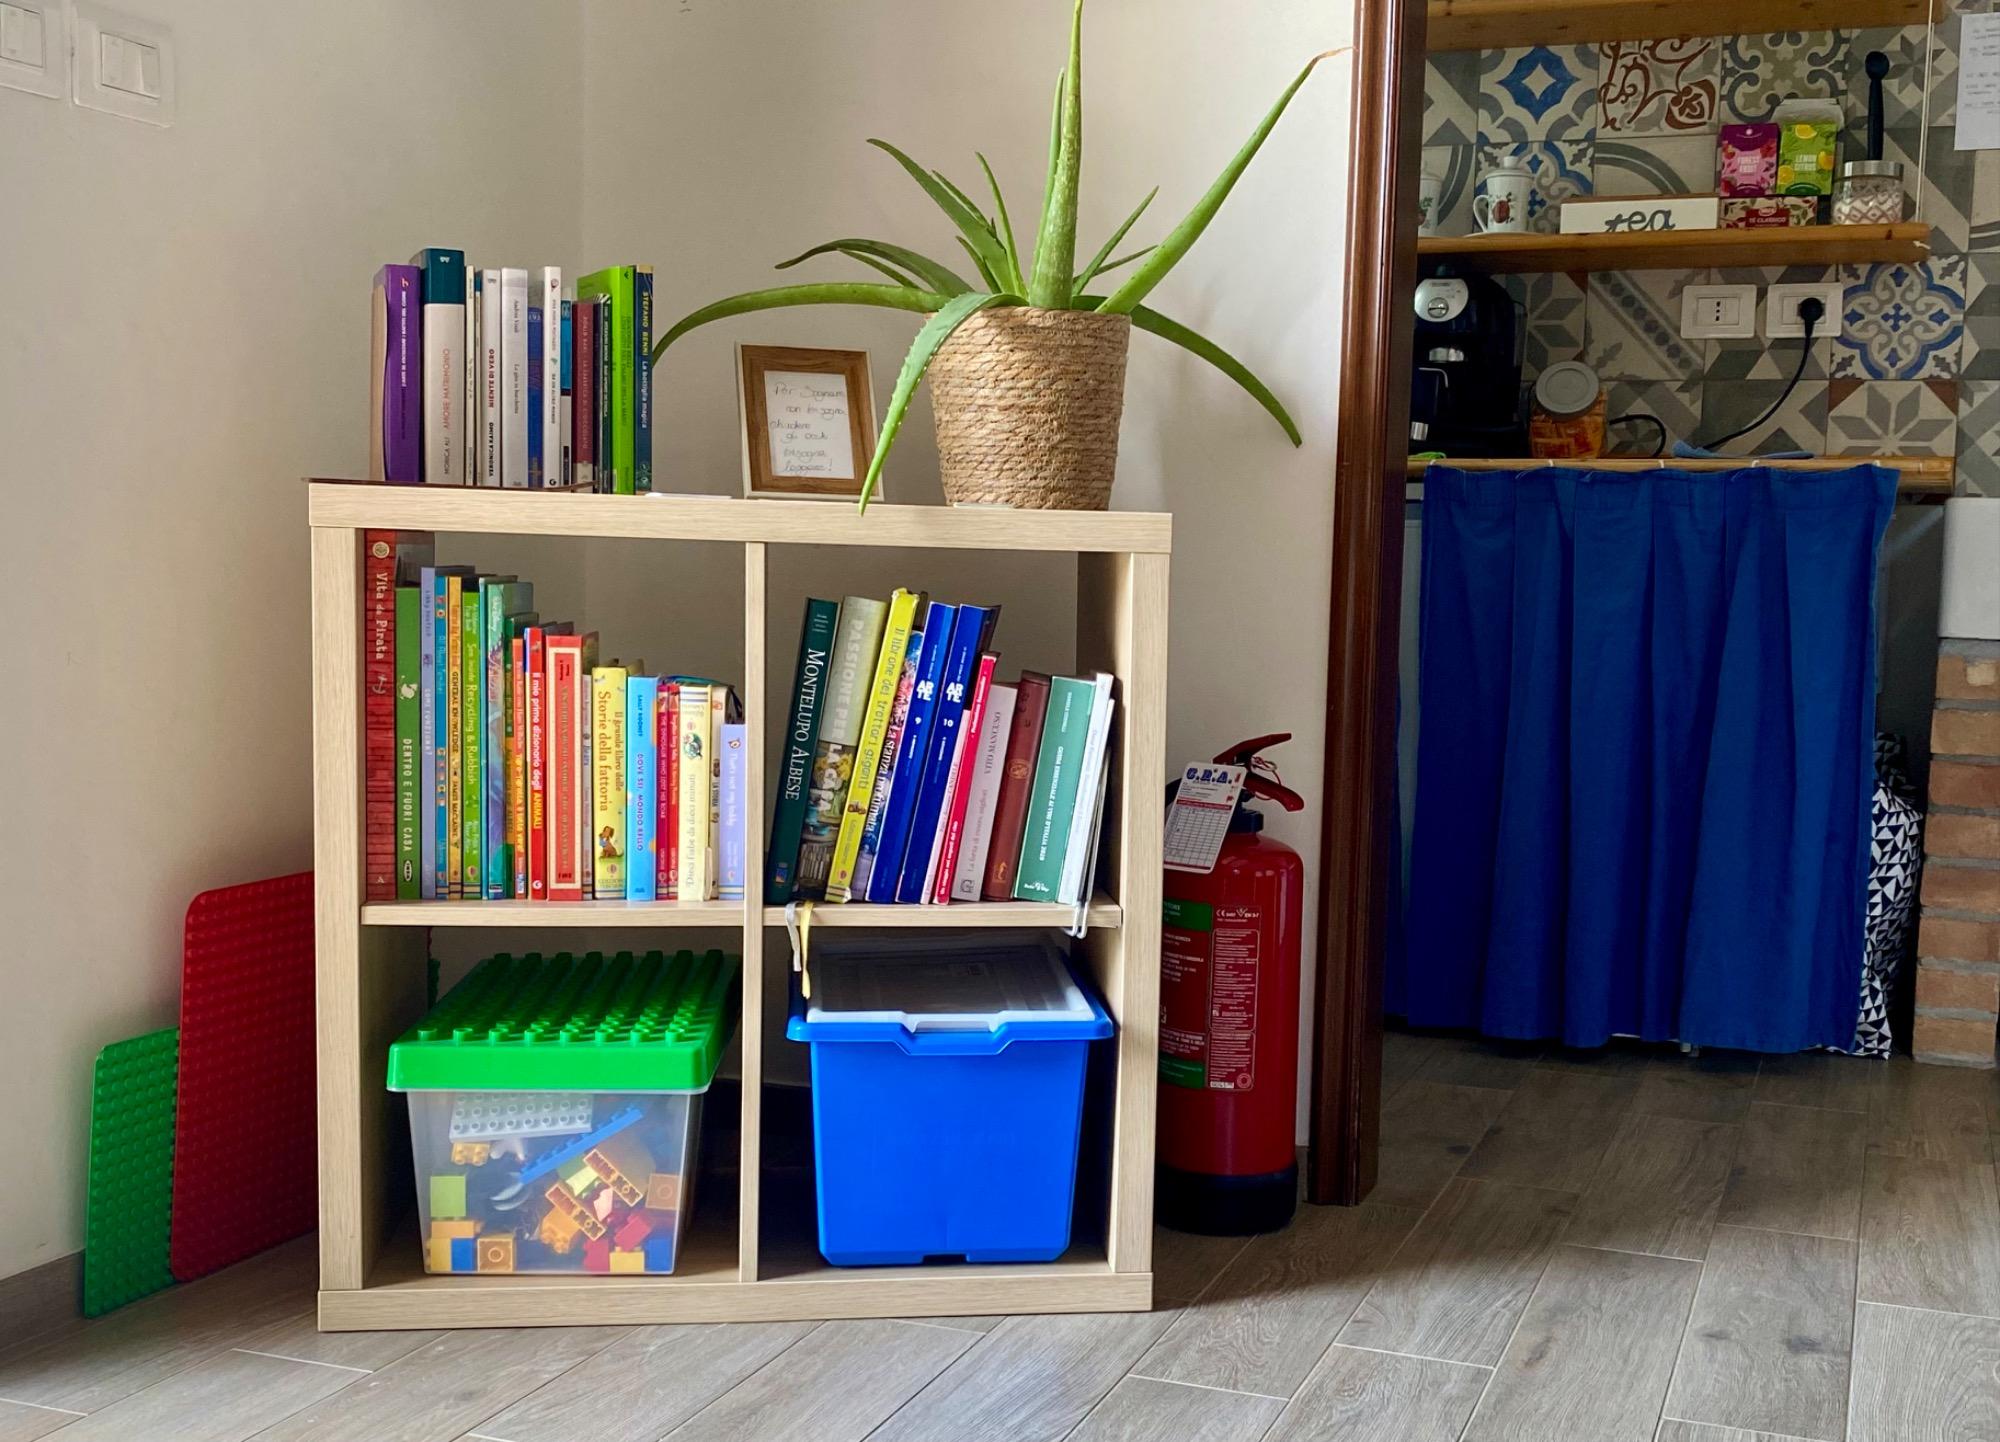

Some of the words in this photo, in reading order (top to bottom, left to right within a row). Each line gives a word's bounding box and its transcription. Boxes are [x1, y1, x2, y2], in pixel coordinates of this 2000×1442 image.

[1604, 209, 1675, 232] tea
[642, 361, 647, 370] La
[376, 572, 388, 599] Vita
[376, 620, 387, 659] Pirata
[893, 627, 905, 636] Il
[467, 644, 476, 657] See
[836, 618, 866, 705] PASSIONE
[883, 636, 902, 676] librone
[533, 680, 541, 696] mio
[792, 647, 826, 743] MONTELUPO
[879, 678, 894, 696] dei
[464, 685, 478, 732] Recycling
[531, 698, 541, 723] primo
[598, 691, 611, 730] Storie
[867, 699, 888, 746] trattori
[914, 716, 922, 726] 9
[943, 718, 954, 727] 10
[613, 720, 623, 748] grande
[830, 706, 849, 740] PER
[886, 724, 900, 739] La
[984, 710, 1004, 753] MANCUSO
[403, 738, 412, 776] DENTRO
[533, 725, 542, 767] dizionario
[599, 733, 611, 761] della
[615, 750, 623, 770] libro
[878, 739, 896, 775] stanza
[467, 746, 477, 784] Rubbish
[783, 745, 810, 801] ALBESE
[856, 747, 876, 790] giganti
[982, 753, 994, 774] VITO
[531, 769, 543, 790] degli
[599, 765, 612, 812] fattoria
[615, 772, 623, 791] delle
[403, 792, 412, 821] FUORI
[534, 792, 543, 829] ANIMALI
[862, 775, 887, 832] profumata
[403, 827, 412, 851] CASA
[688, 828, 695, 837] da
[1040, 820, 1052, 846] D'ITALIA
[686, 862, 694, 886] Dieci
